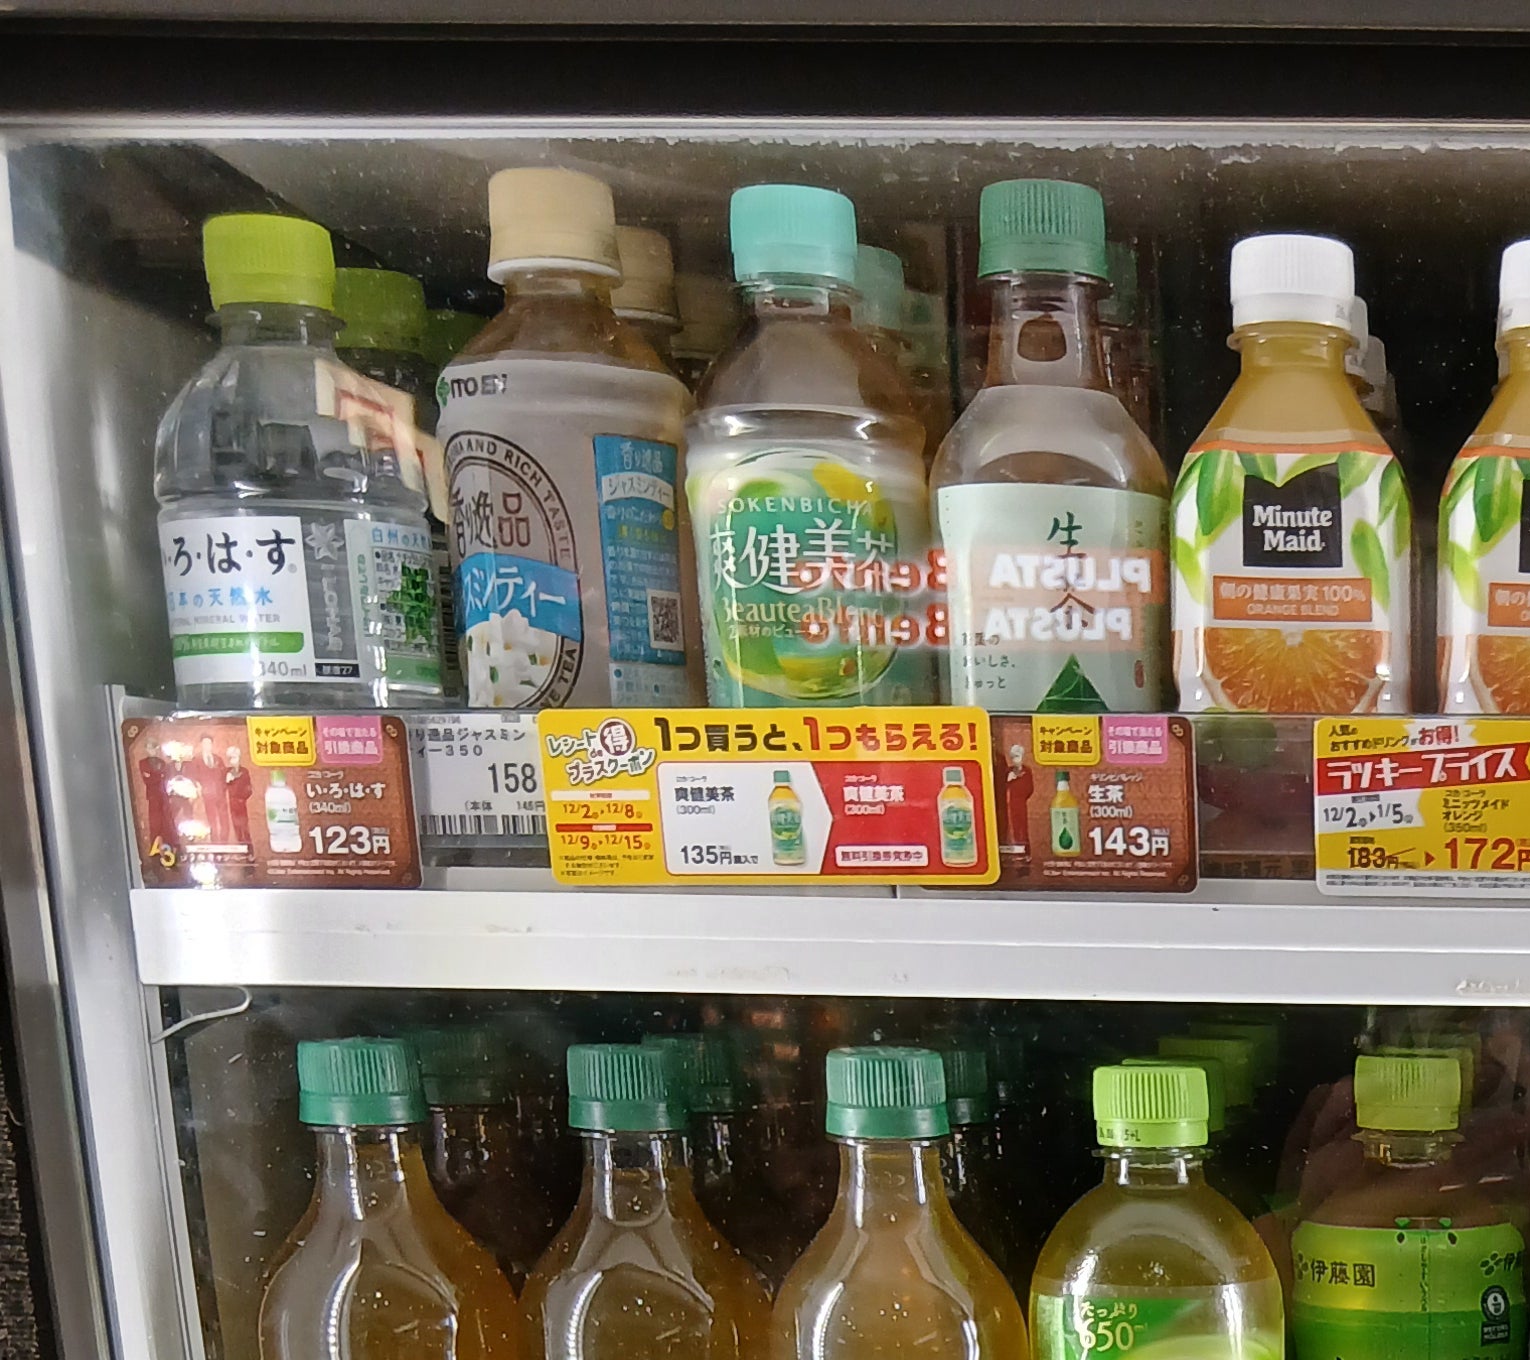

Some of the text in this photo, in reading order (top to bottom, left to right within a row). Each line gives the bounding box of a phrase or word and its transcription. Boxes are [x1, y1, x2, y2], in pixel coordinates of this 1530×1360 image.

[1253, 505, 1332, 528] Minute
[1264, 529, 1324, 553] Maid
[603, 722, 632, 753] 得
[1326, 747, 1518, 791] ラッキープライス
[1311, 1258, 1376, 1288] 伊藤園
